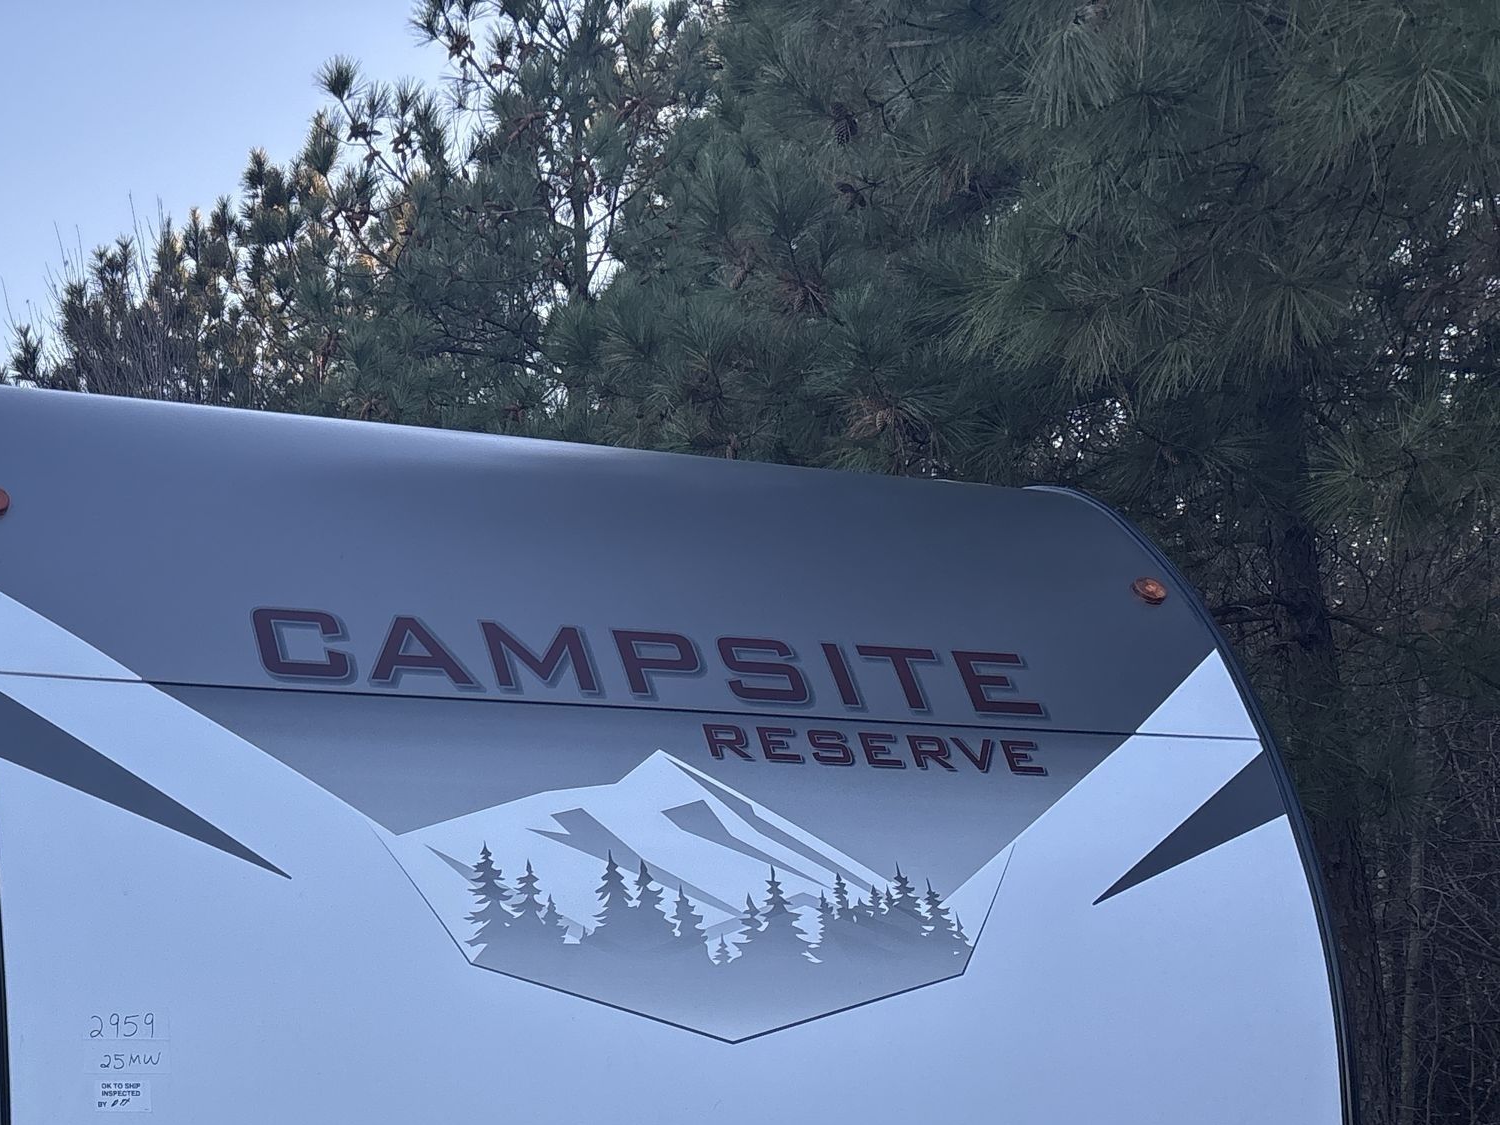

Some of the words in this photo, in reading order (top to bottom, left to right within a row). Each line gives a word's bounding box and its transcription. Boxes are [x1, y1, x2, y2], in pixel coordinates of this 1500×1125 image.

[250, 606, 1048, 718] CAMPSITE
[702, 722, 1048, 775] RESERVE
[89, 1012, 155, 1038] 2959
